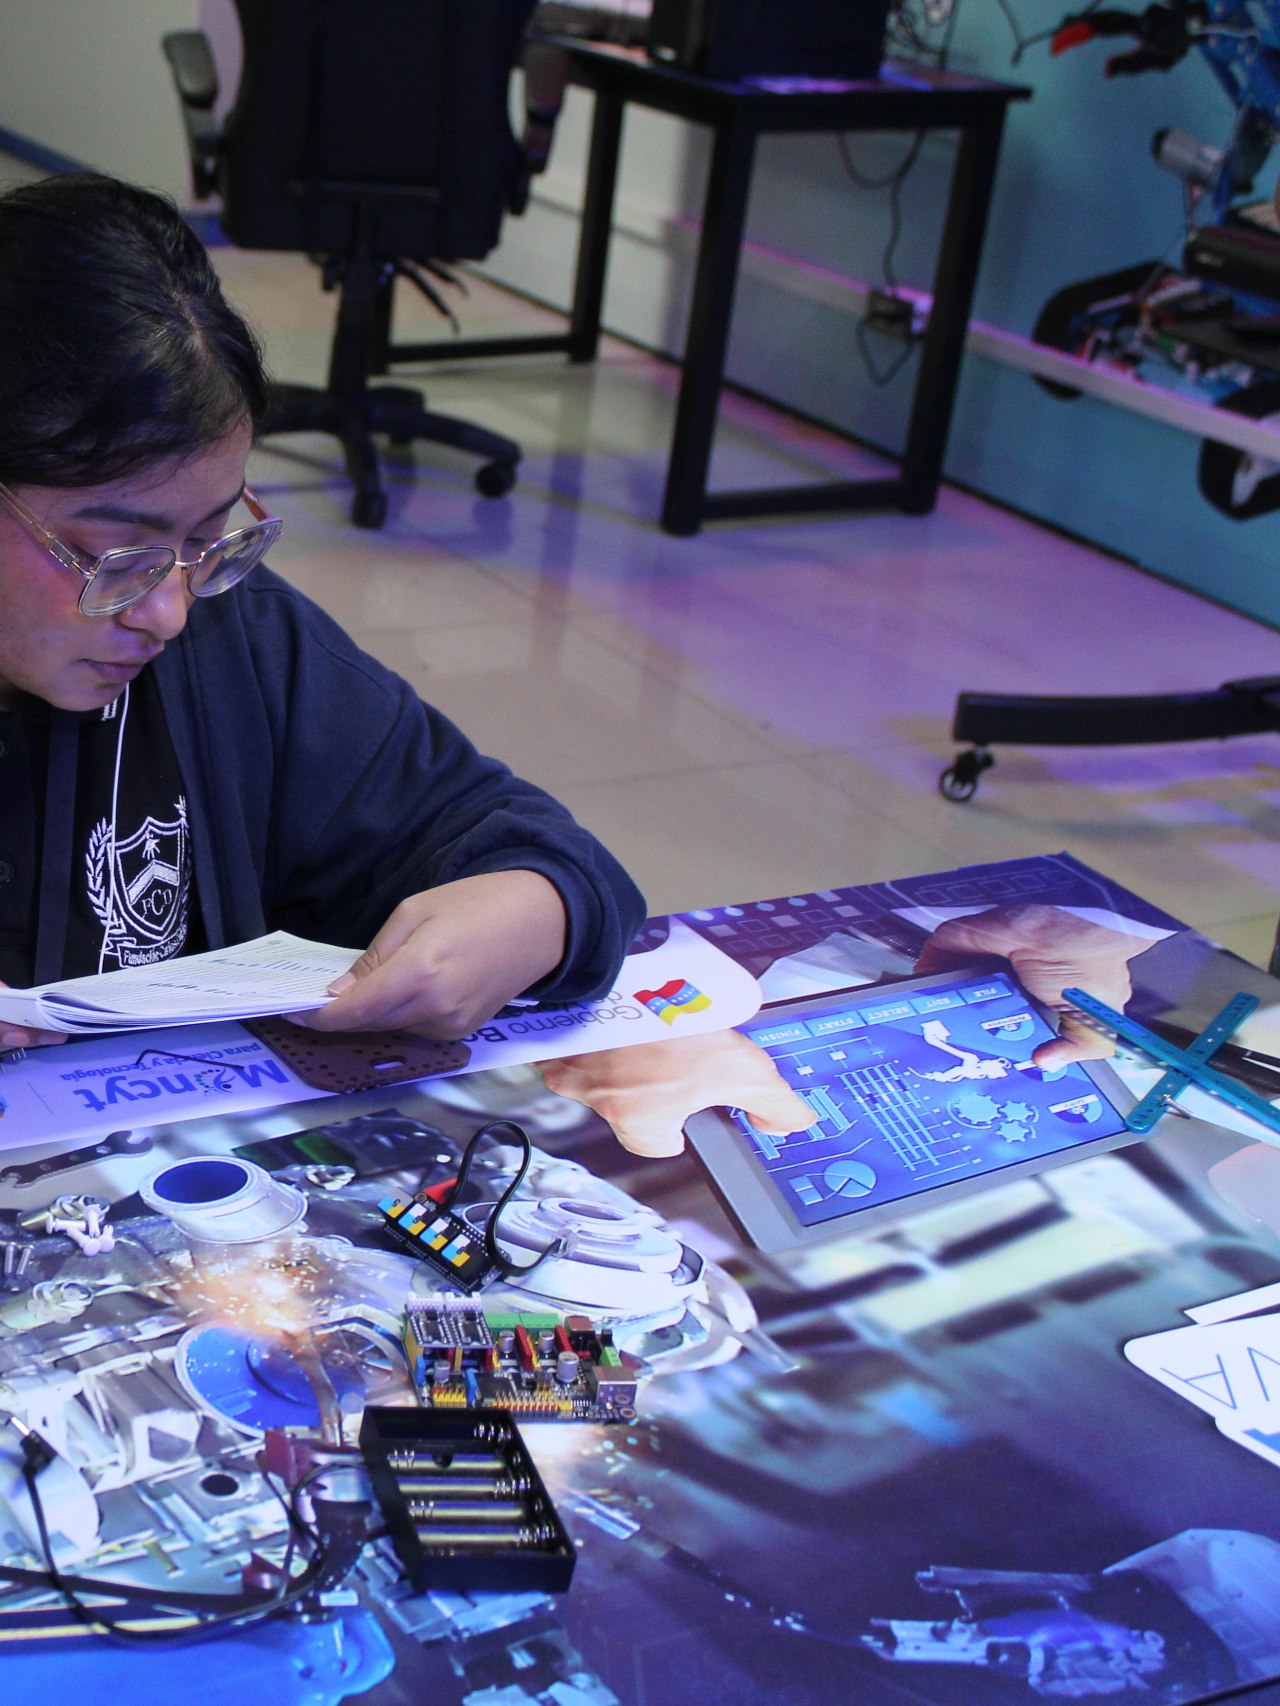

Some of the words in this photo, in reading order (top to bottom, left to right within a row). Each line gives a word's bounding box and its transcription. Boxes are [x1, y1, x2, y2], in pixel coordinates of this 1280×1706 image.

[973, 987, 998, 998] FILE
[926, 997, 951, 1008] EDIT
[508, 1004, 644, 1035] Gobierno
[868, 1006, 910, 1020] SELECT
[818, 1018, 854, 1030] START
[758, 1028, 801, 1043] FINISH
[223, 1042, 262, 1056] para
[151, 1057, 163, 1067] y
[163, 1049, 223, 1068] Cienia
